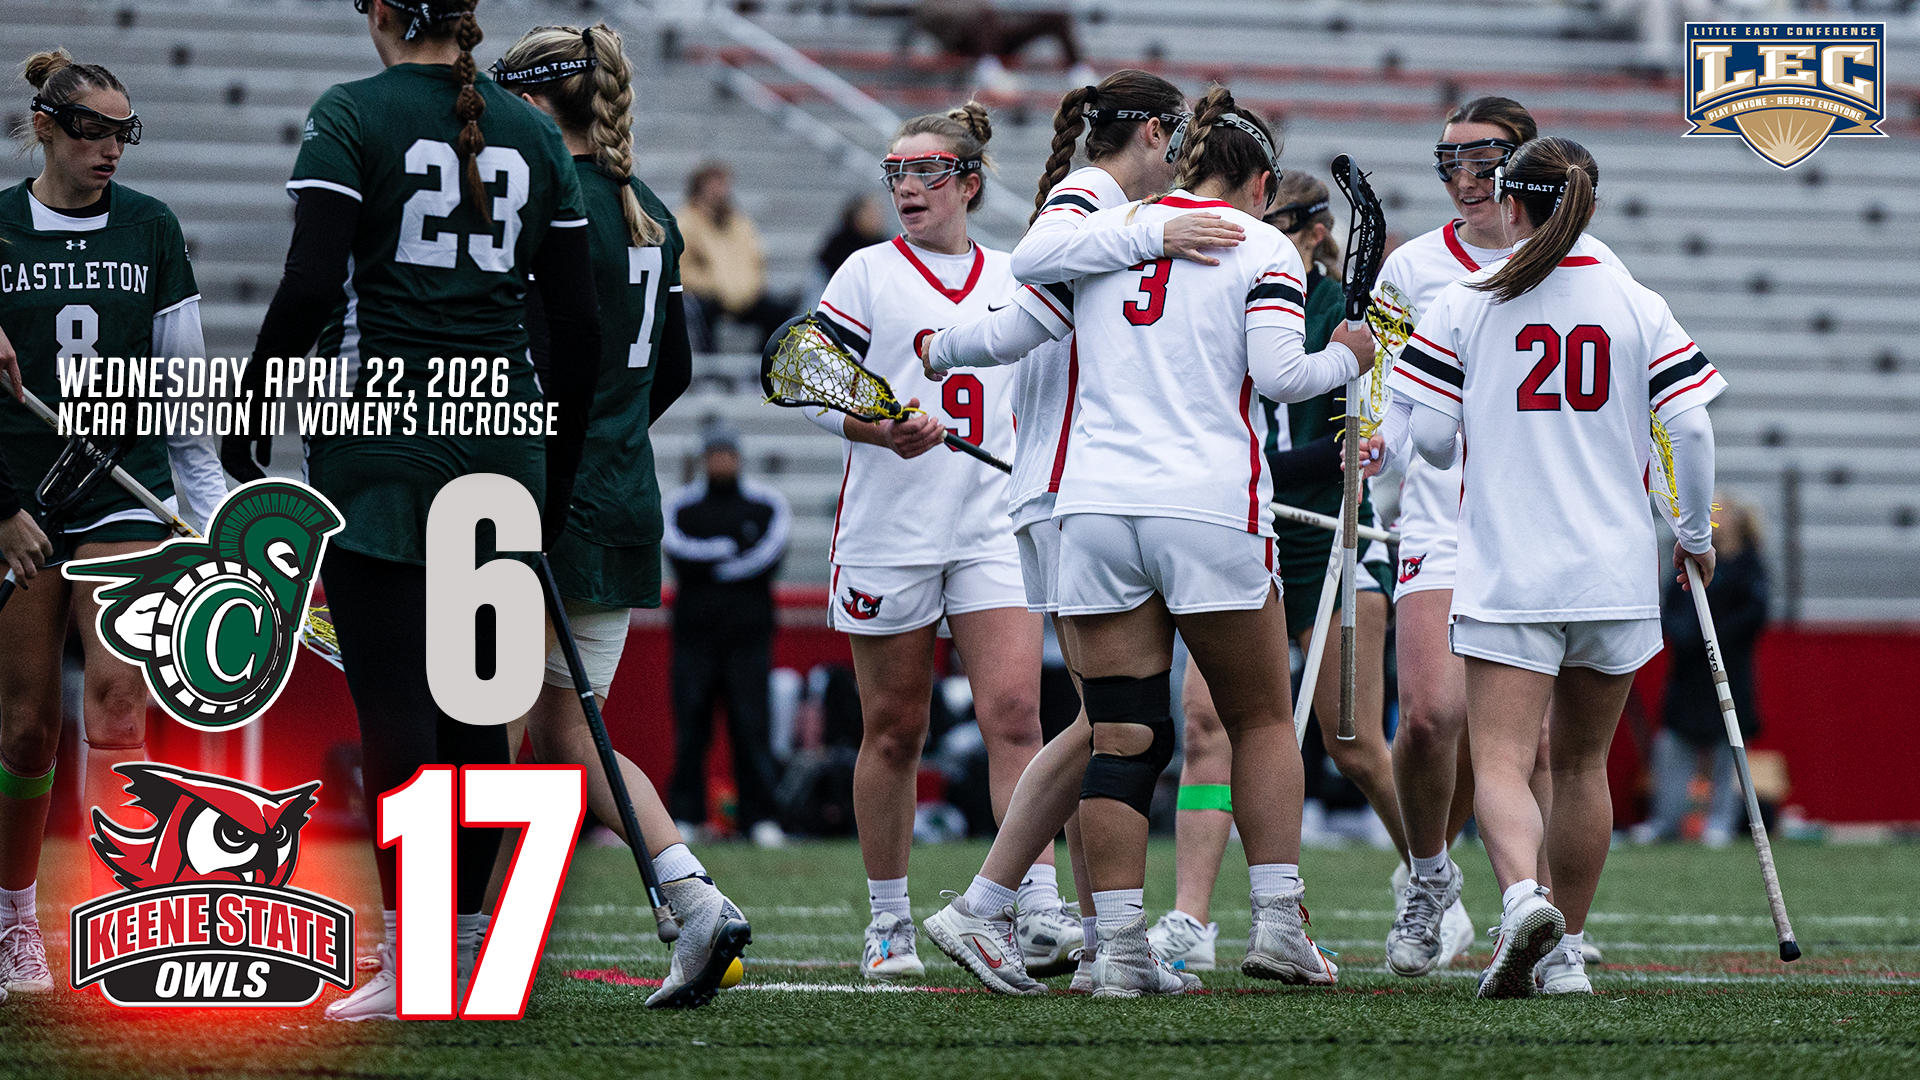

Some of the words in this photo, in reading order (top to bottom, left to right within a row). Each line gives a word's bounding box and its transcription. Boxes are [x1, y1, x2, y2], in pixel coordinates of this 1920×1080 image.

[560, 60, 588, 71] GAIT
[1116, 109, 1150, 120] STX
[1238, 120, 1267, 147] STX
[394, 138, 531, 274] 23
[1505, 180, 1524, 190] GAIT
[1527, 183, 1555, 192] GAIT
[0, 261, 149, 294] CASTLETON
[1122, 256, 1174, 327] 3
[627, 246, 663, 368] 7
[55, 304, 99, 386] 8
[1515, 323, 1611, 412] 20
[941, 373, 984, 452] 9
[1704, 638, 1719, 673] GAIT
